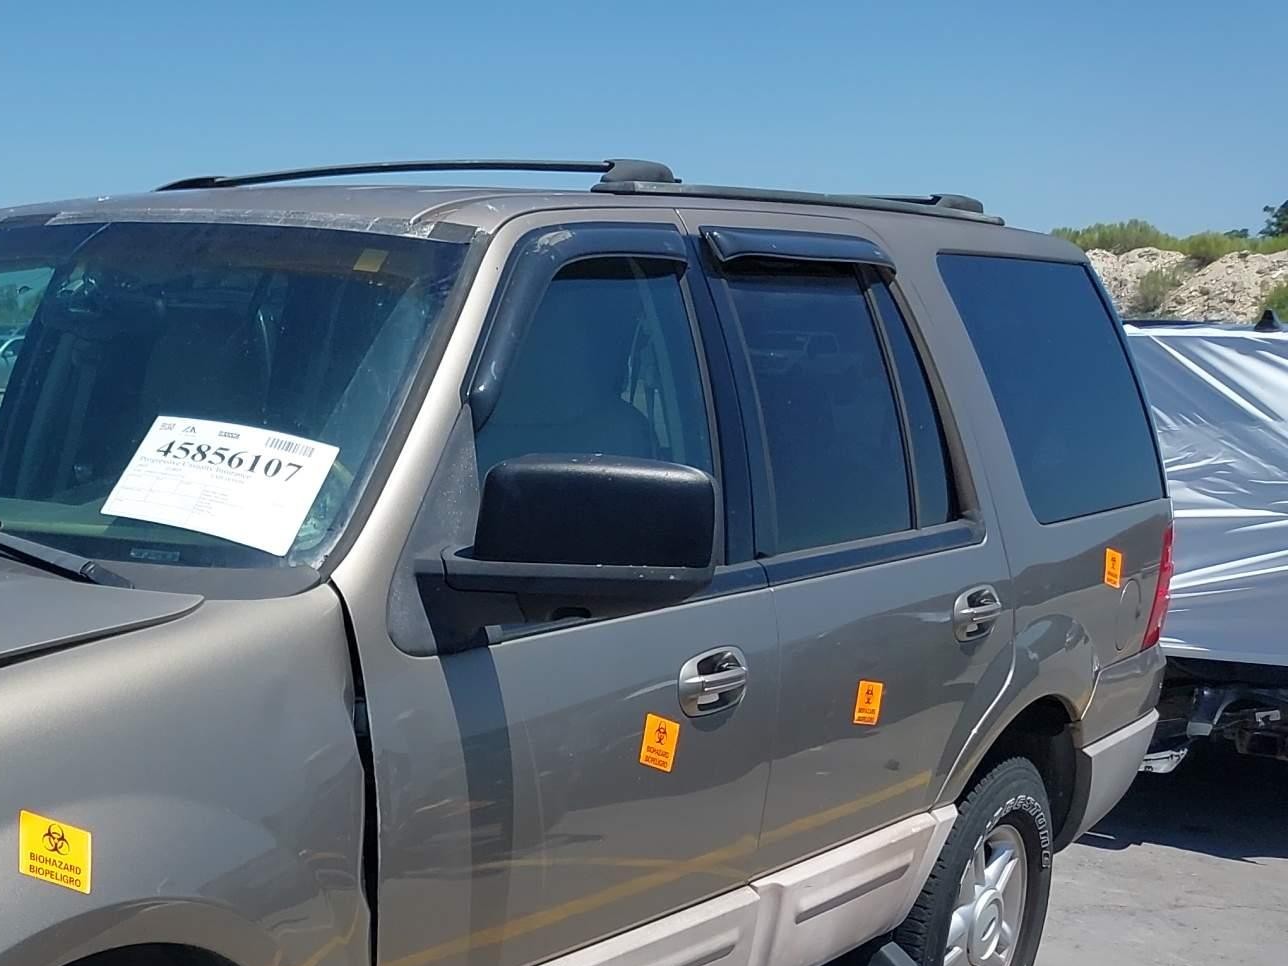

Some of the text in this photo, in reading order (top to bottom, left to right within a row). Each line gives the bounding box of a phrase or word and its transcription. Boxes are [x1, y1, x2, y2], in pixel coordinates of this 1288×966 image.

[156, 439, 304, 482] 45856107
[29, 851, 82, 875] BIOHAZARD
[29, 864, 81, 888] BIOPELIGRO
